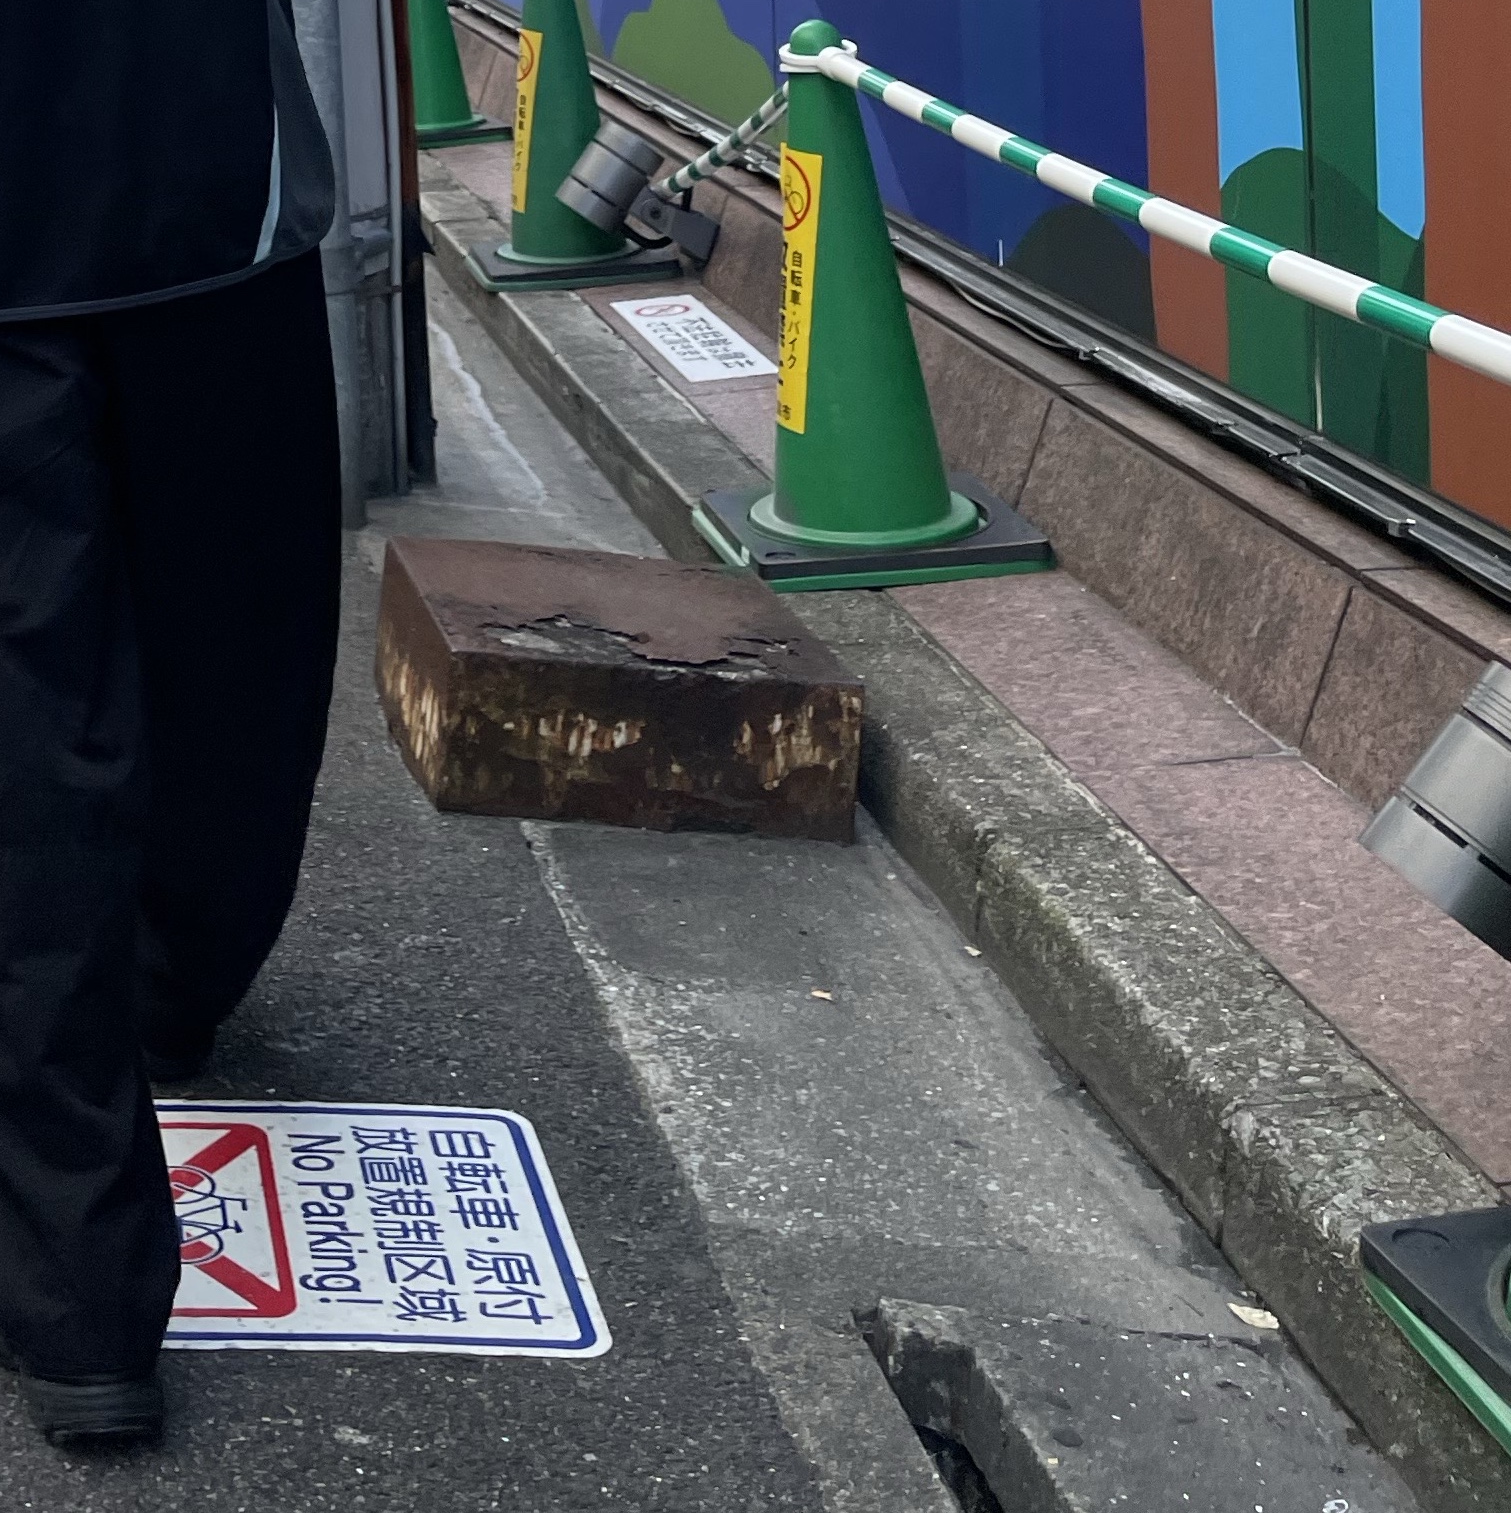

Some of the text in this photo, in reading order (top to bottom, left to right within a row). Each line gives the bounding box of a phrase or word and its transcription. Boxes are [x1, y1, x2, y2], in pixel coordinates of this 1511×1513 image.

[787, 250, 803, 370] 自転車・バイク
[287, 1133, 384, 1305] No Parking!
[349, 1125, 468, 1323] 放置規制区域
[428, 1129, 554, 1325] 自転車・原付
